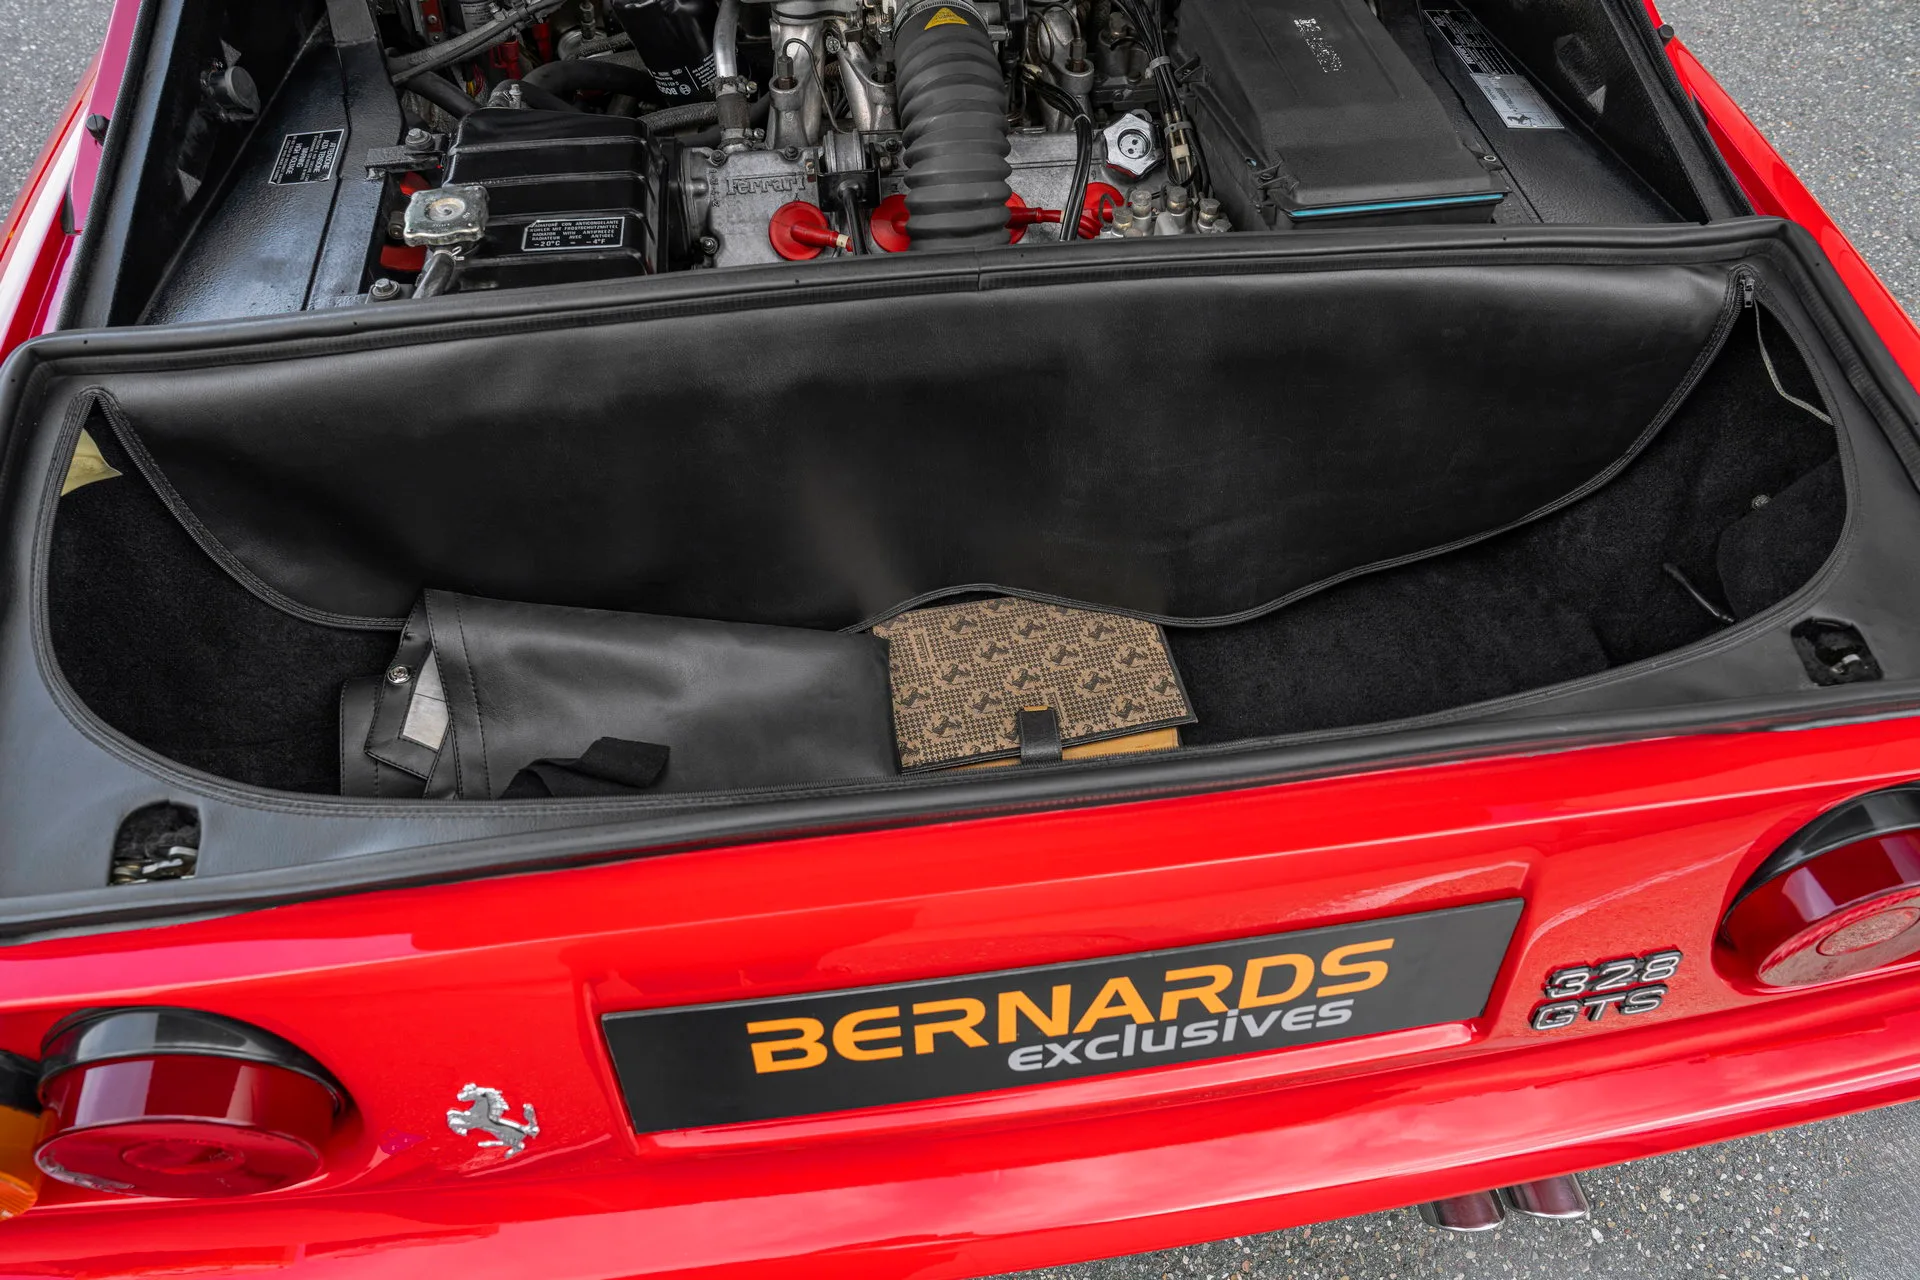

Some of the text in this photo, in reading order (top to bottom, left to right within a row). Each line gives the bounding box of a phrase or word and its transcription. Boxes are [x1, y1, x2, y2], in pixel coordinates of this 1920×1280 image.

[725, 172, 806, 196] Ferrari
[1544, 948, 1684, 999] 328
[746, 938, 1395, 1075] BERNARDS
[1530, 983, 1669, 1031] GTS
[1007, 999, 1356, 1073] exclusives
